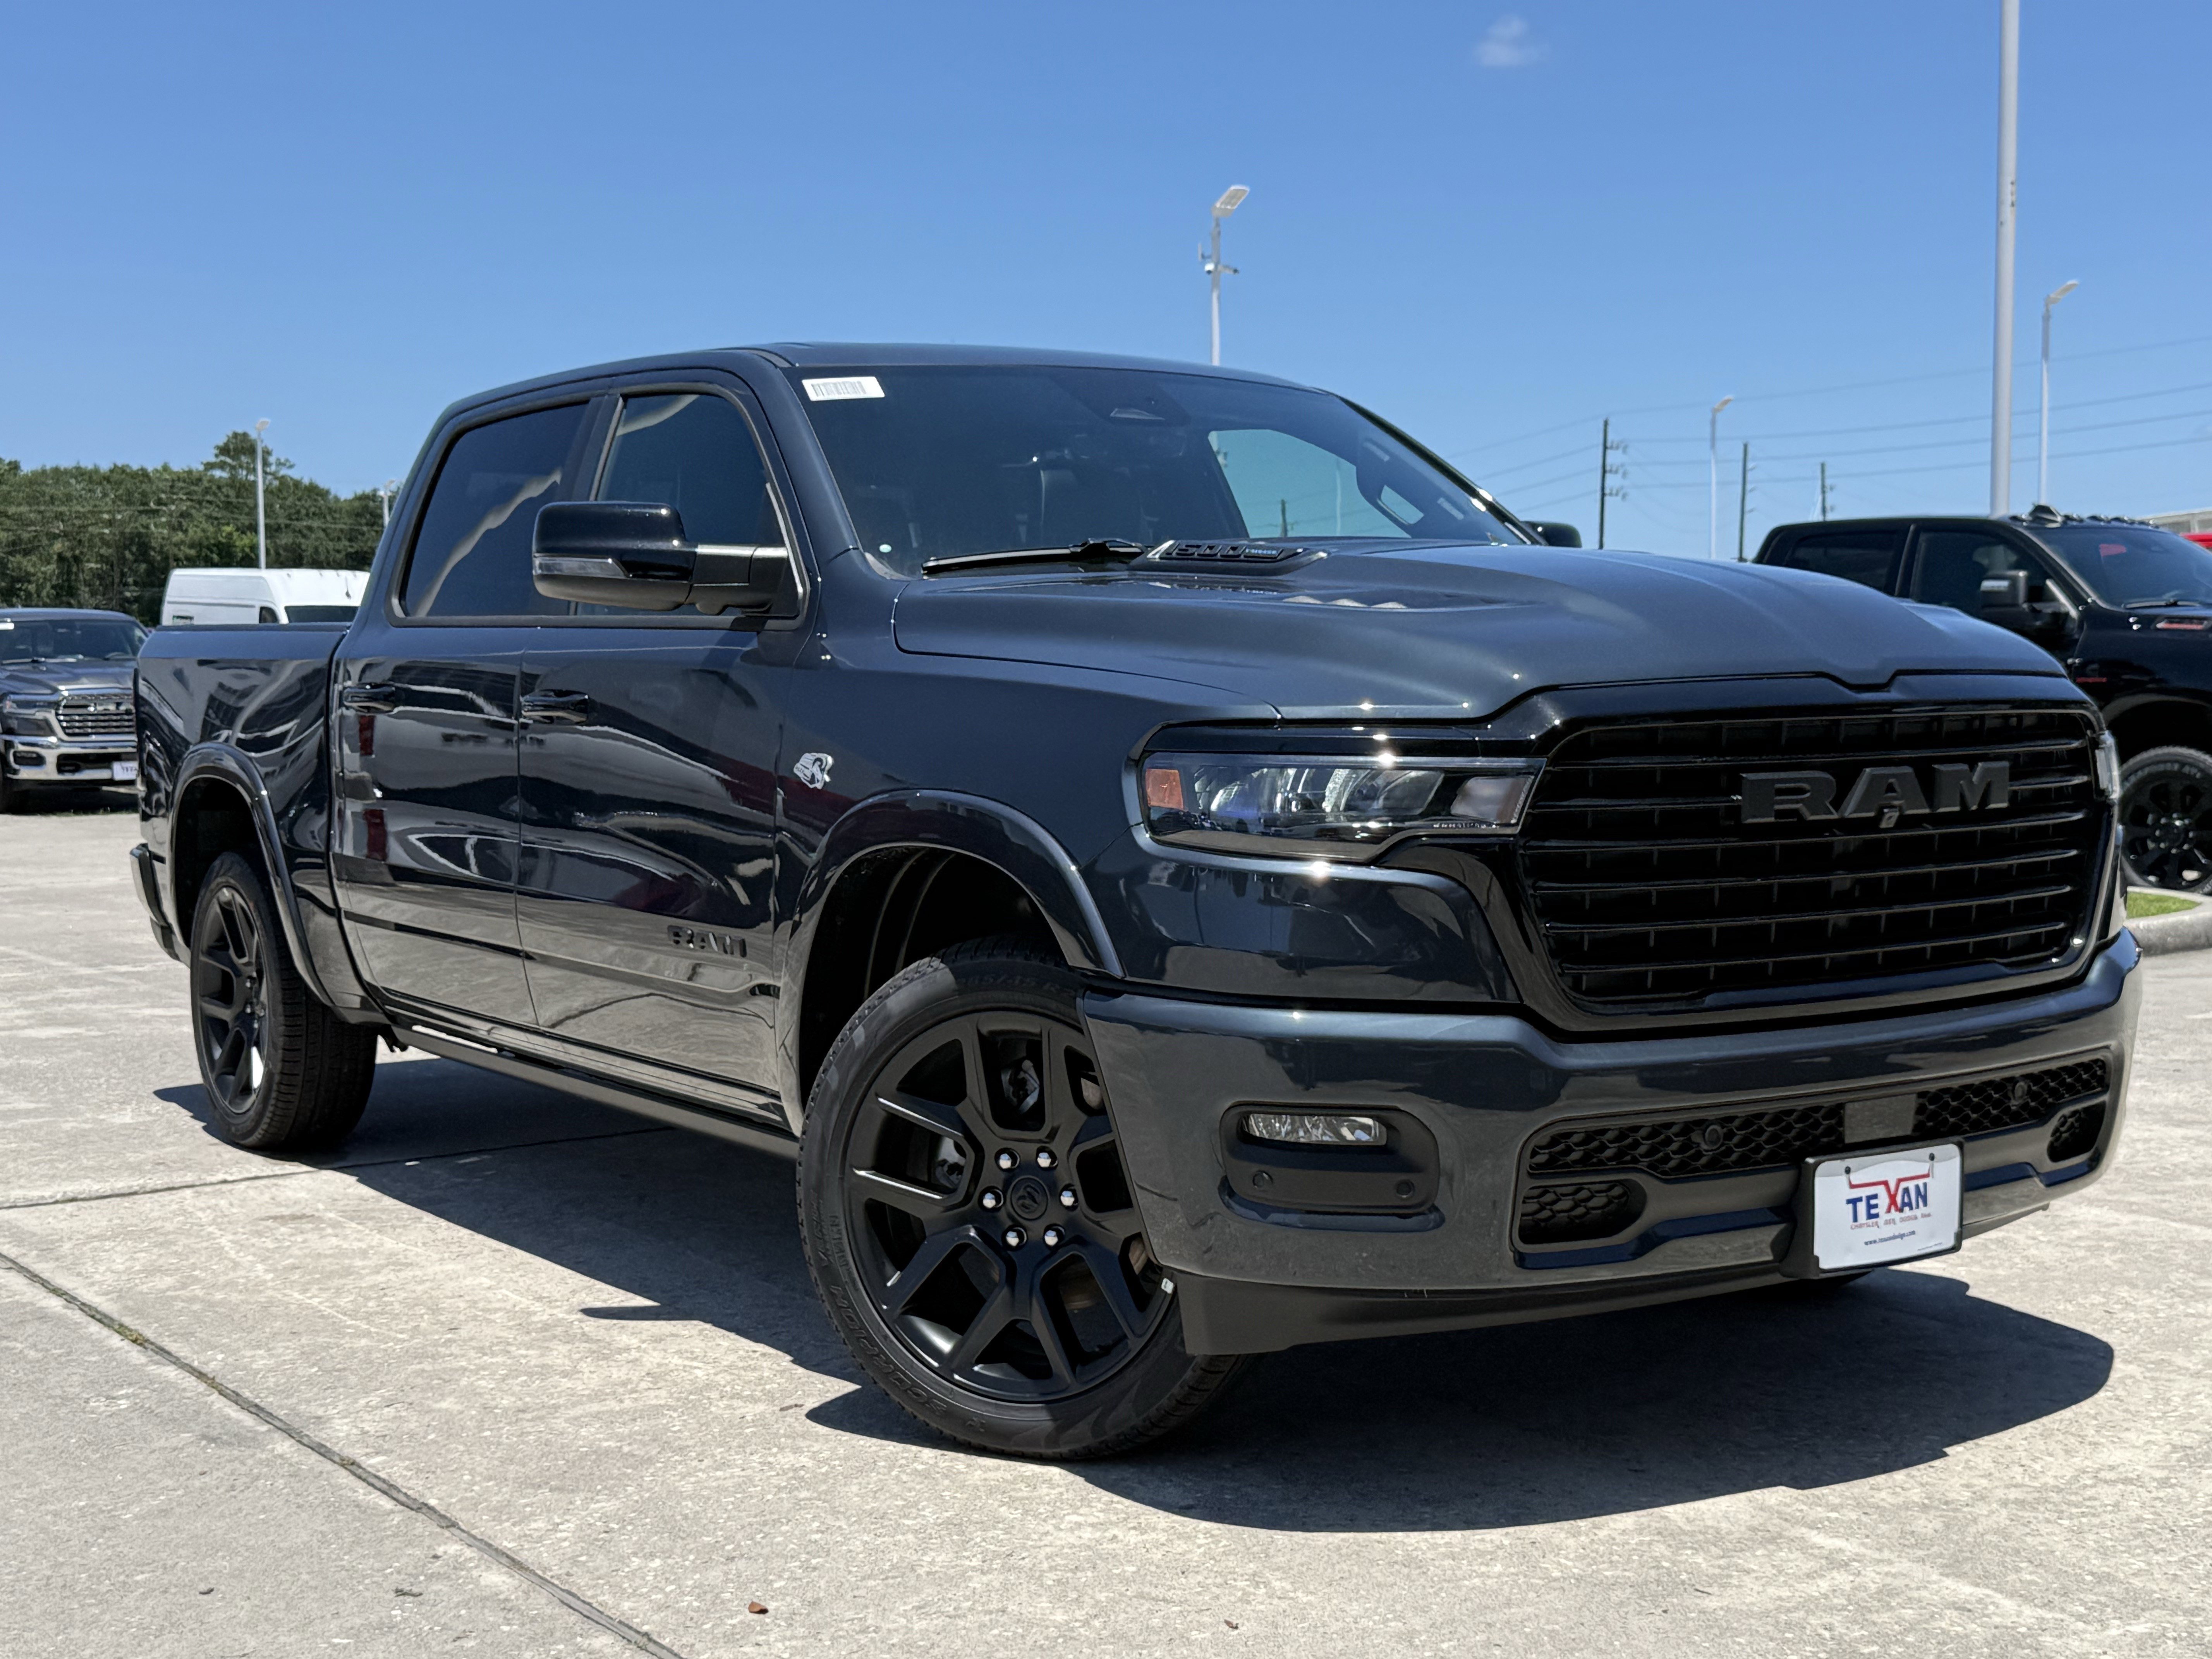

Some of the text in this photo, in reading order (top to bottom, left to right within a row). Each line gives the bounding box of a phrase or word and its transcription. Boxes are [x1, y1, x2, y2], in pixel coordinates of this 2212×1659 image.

[1740, 761, 2010, 824] RAM
[667, 925, 747, 958] RAM
[1846, 1180, 1928, 1223] TEXAN
[830, 1285, 948, 1416] SCORPION
